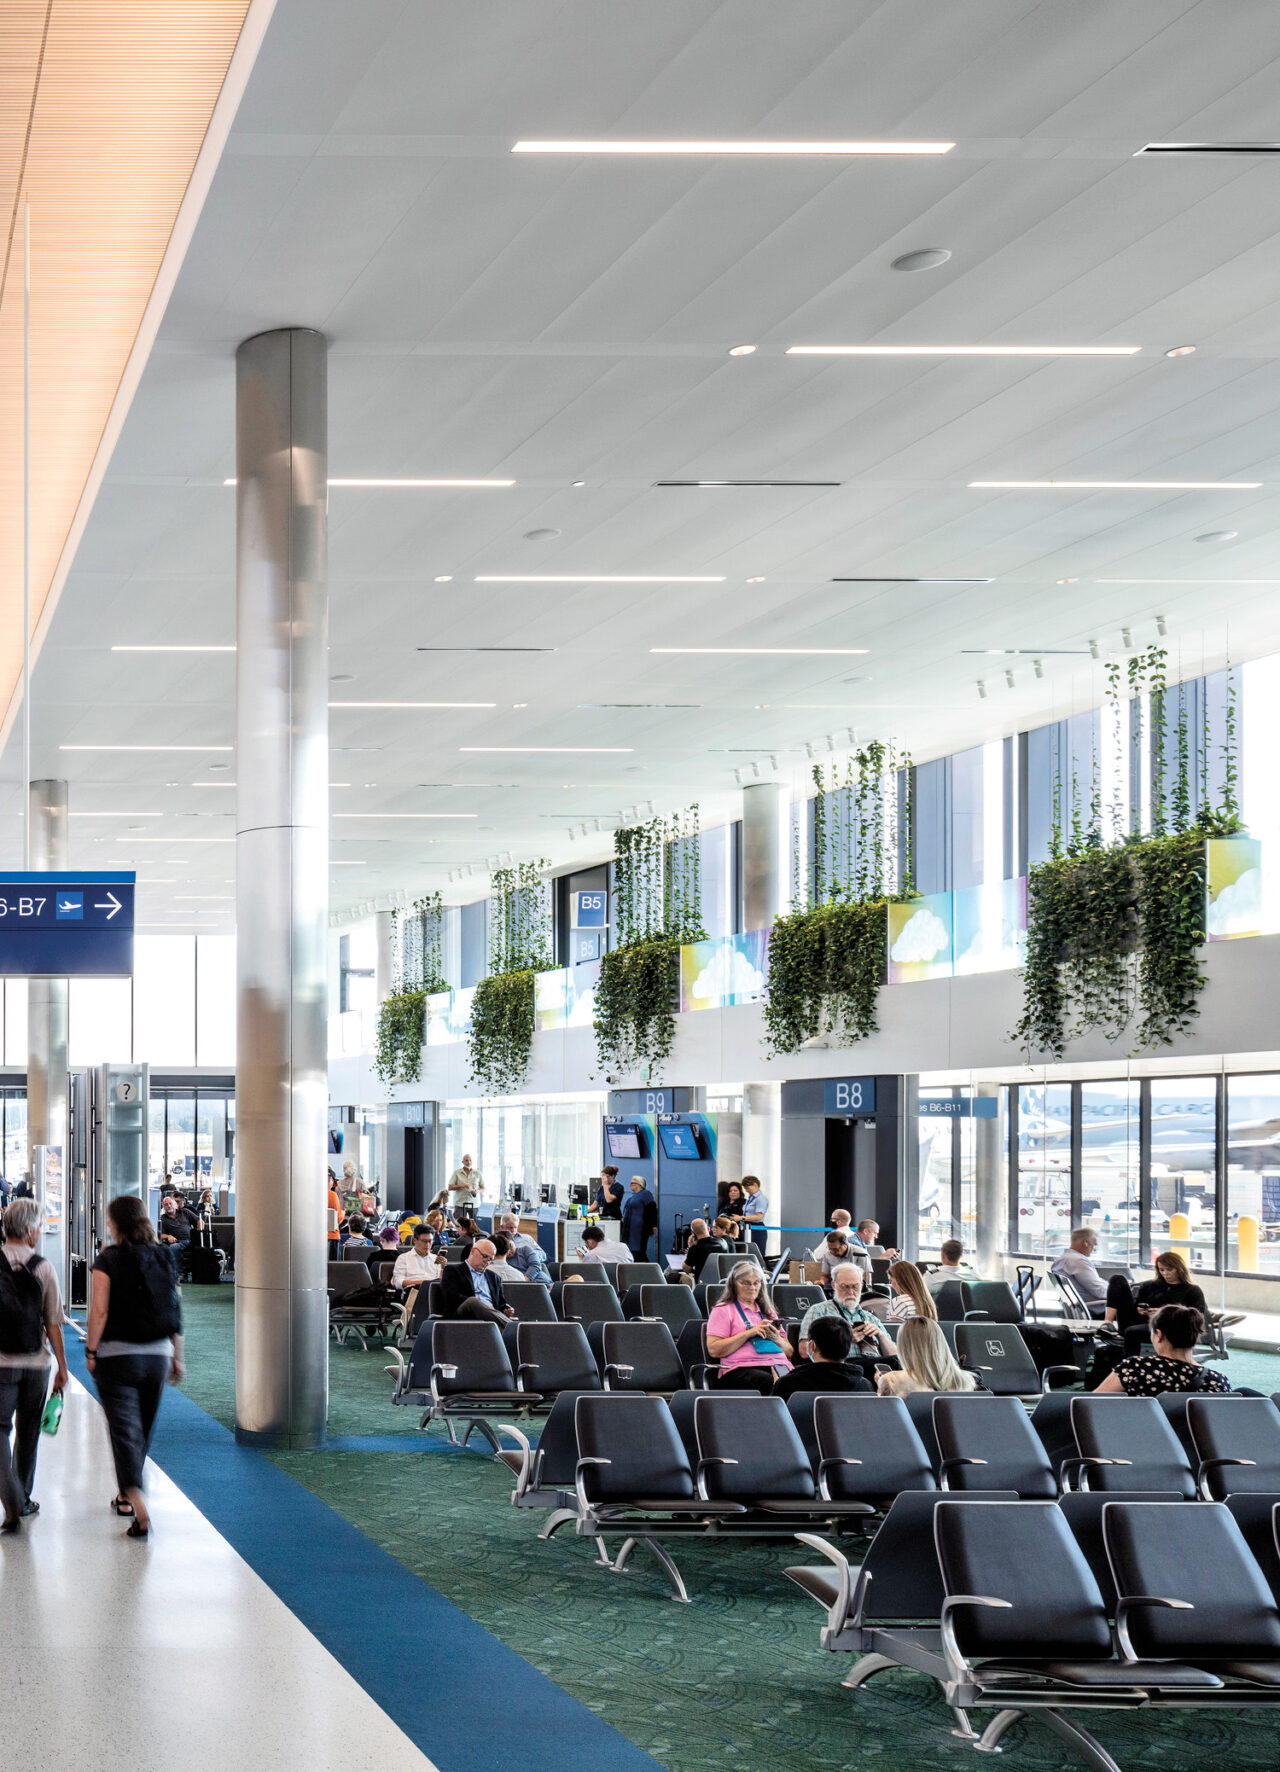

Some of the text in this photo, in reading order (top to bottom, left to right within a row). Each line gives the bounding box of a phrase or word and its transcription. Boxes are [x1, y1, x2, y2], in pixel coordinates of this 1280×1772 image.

[582, 897, 601, 909] B5
[581, 941, 593, 957] B5
[646, 1093, 665, 1114] B9
[836, 1082, 862, 1109] B8
[406, 1105, 421, 1121] B10
[929, 1103, 961, 1112] B6-B11
